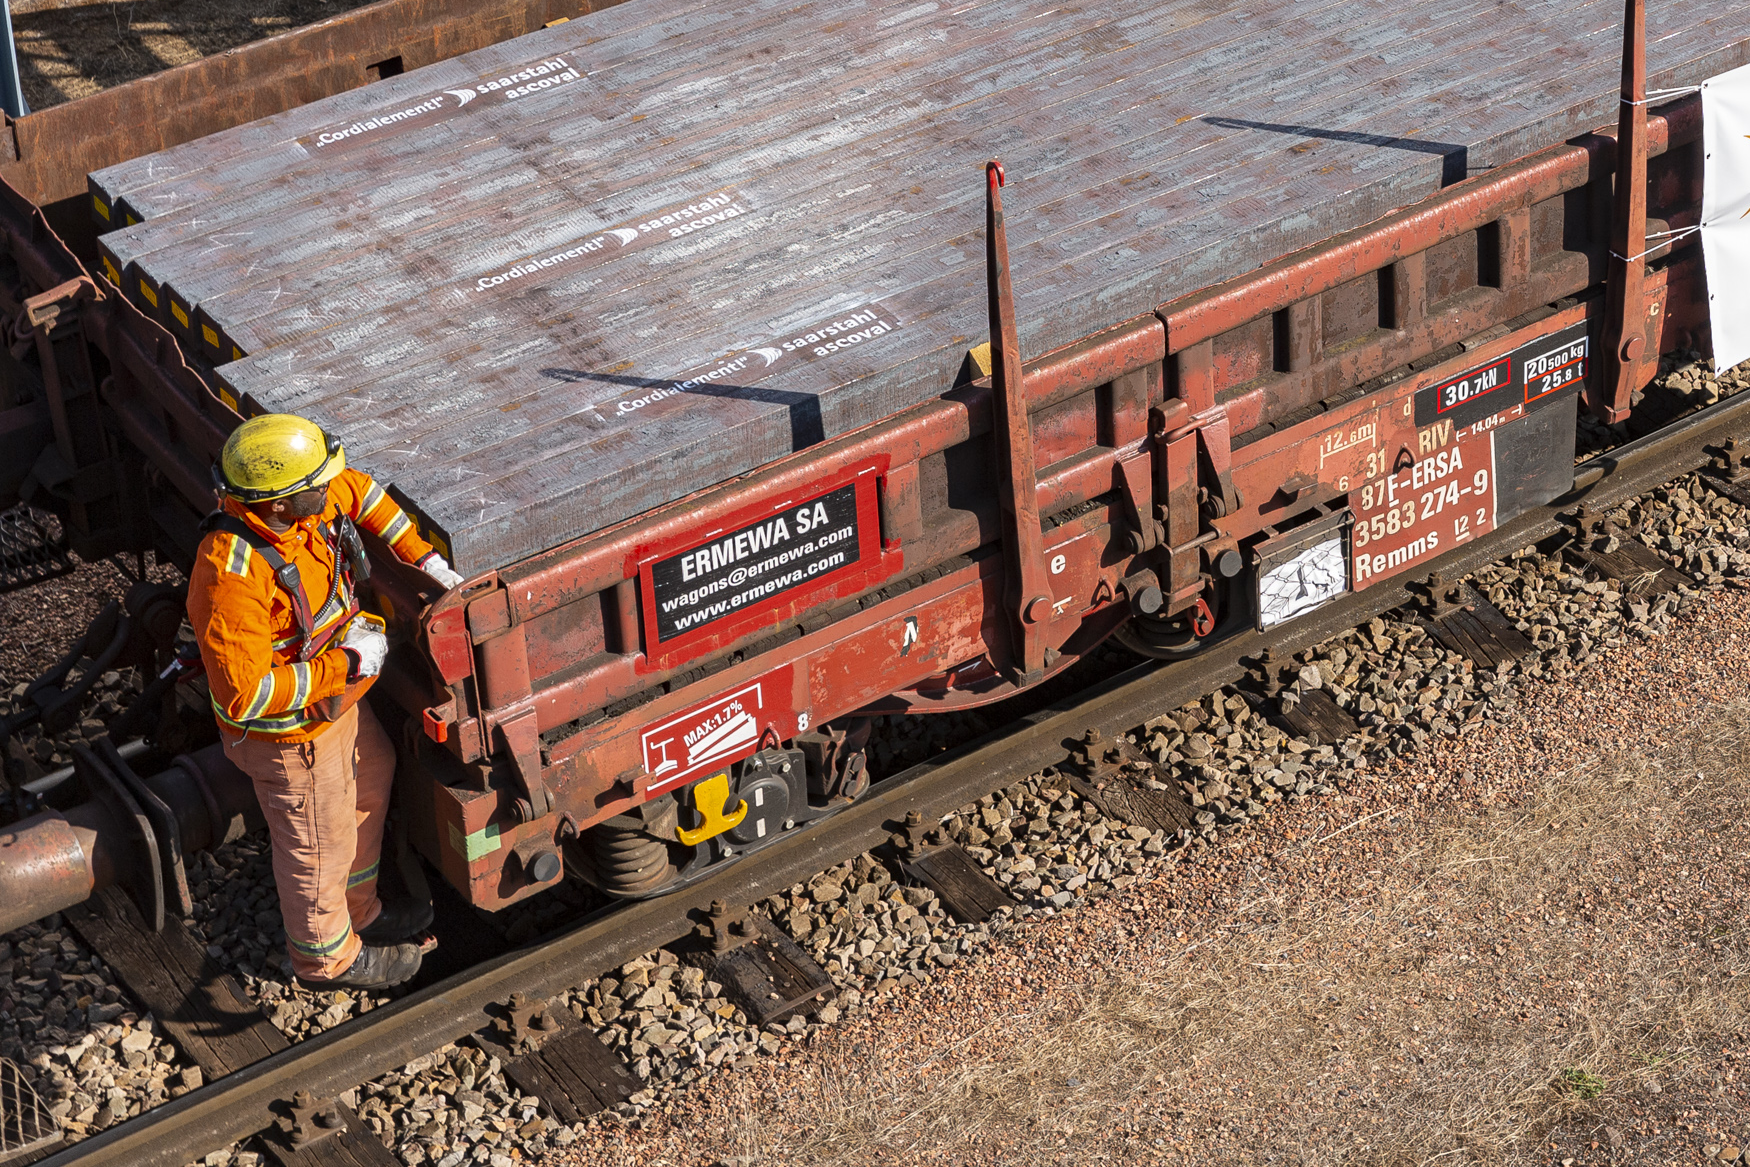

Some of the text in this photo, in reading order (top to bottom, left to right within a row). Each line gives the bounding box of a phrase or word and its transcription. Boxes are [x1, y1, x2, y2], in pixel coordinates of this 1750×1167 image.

[477, 57, 568, 94] saarstahl
[505, 68, 580, 99] ascoval
[638, 193, 732, 232] saarstahl
[668, 203, 746, 237] ascoval
[782, 309, 878, 352] saarstahl
[813, 320, 892, 357] ascoval
[1570, 345, 1584, 359] kg
[1541, 362, 1584, 393] 25.8 t
[1403, 396, 1412, 416] d
[1366, 419, 1452, 479] 31 RIV
[1339, 475, 1349, 492] 6
[1355, 469, 1488, 548] 3583 274-9
[681, 502, 829, 582] ERMEWA SA
[1355, 530, 1439, 582] Remms
[1476, 507, 1486, 525] 2
[662, 525, 853, 613] wagons@ermewa.com
[1050, 554, 1066, 575] e
[674, 552, 845, 630] www.ermewa.com
[797, 713, 809, 732] 8
